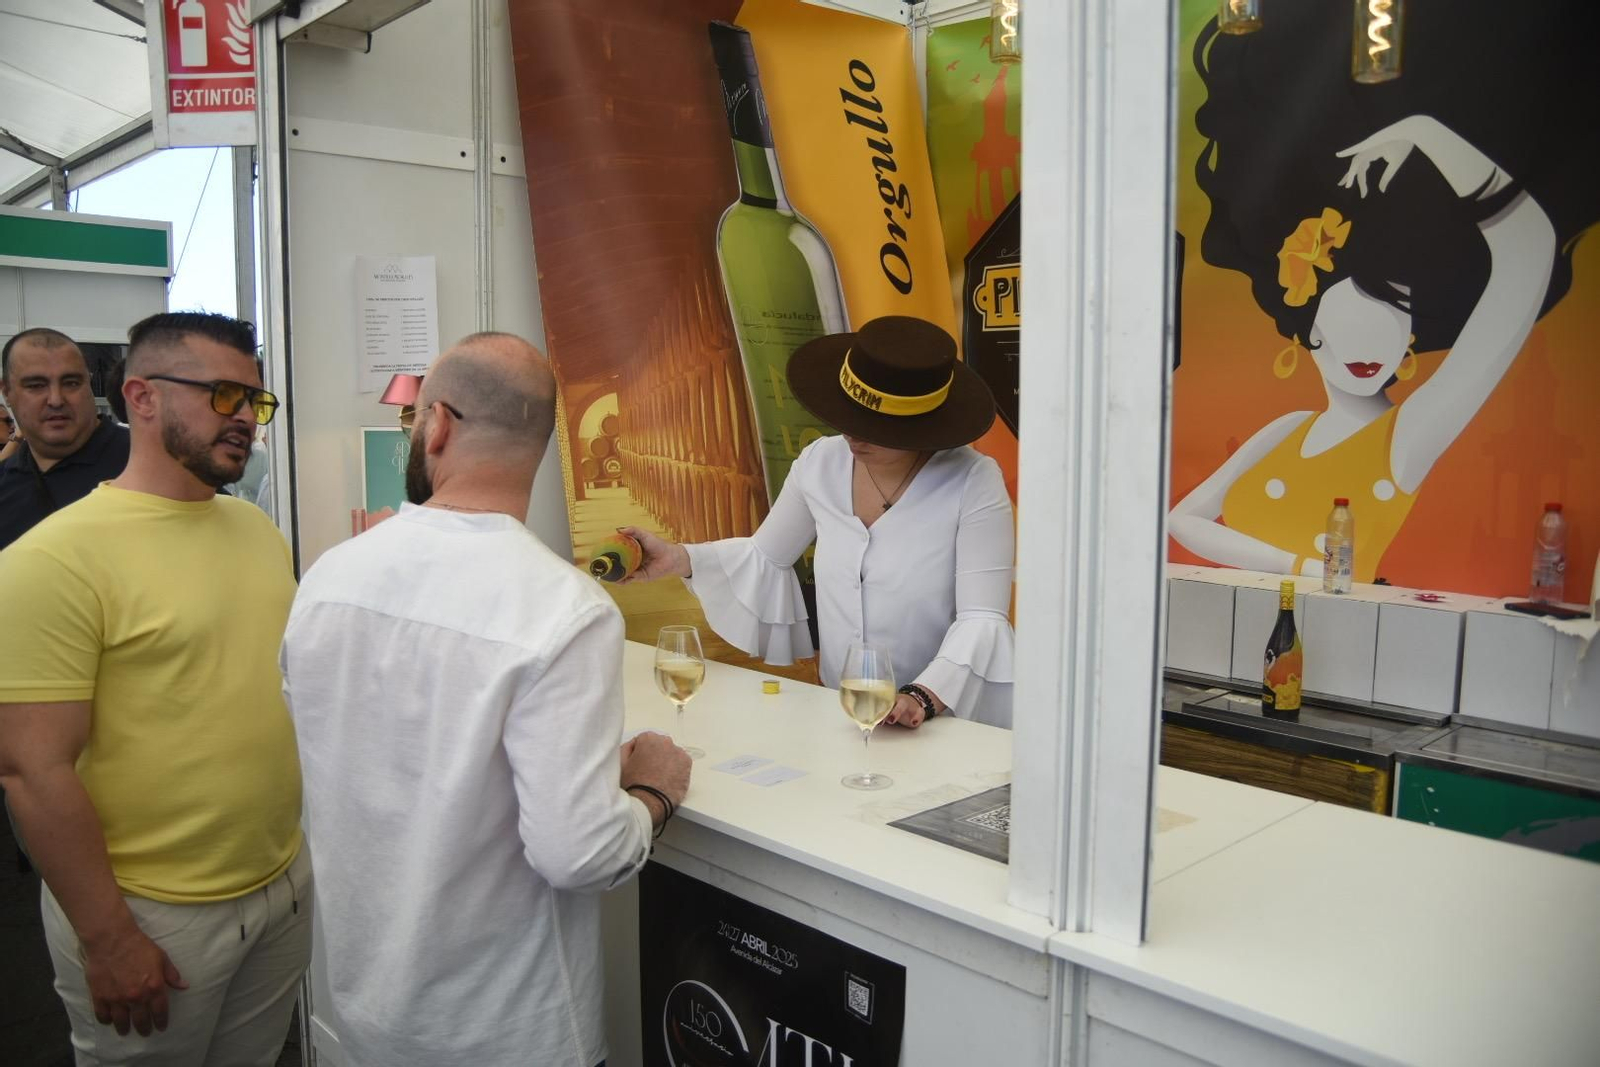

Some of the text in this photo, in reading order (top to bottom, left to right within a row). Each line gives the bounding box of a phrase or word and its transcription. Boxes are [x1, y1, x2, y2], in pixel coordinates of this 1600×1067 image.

[173, 87, 256, 107] EXTINTOR
[839, 59, 913, 295] Orgullo
[741, 932, 771, 957] ABRIL
[771, 944, 799, 969] 2025
[690, 998, 722, 1037] 150
